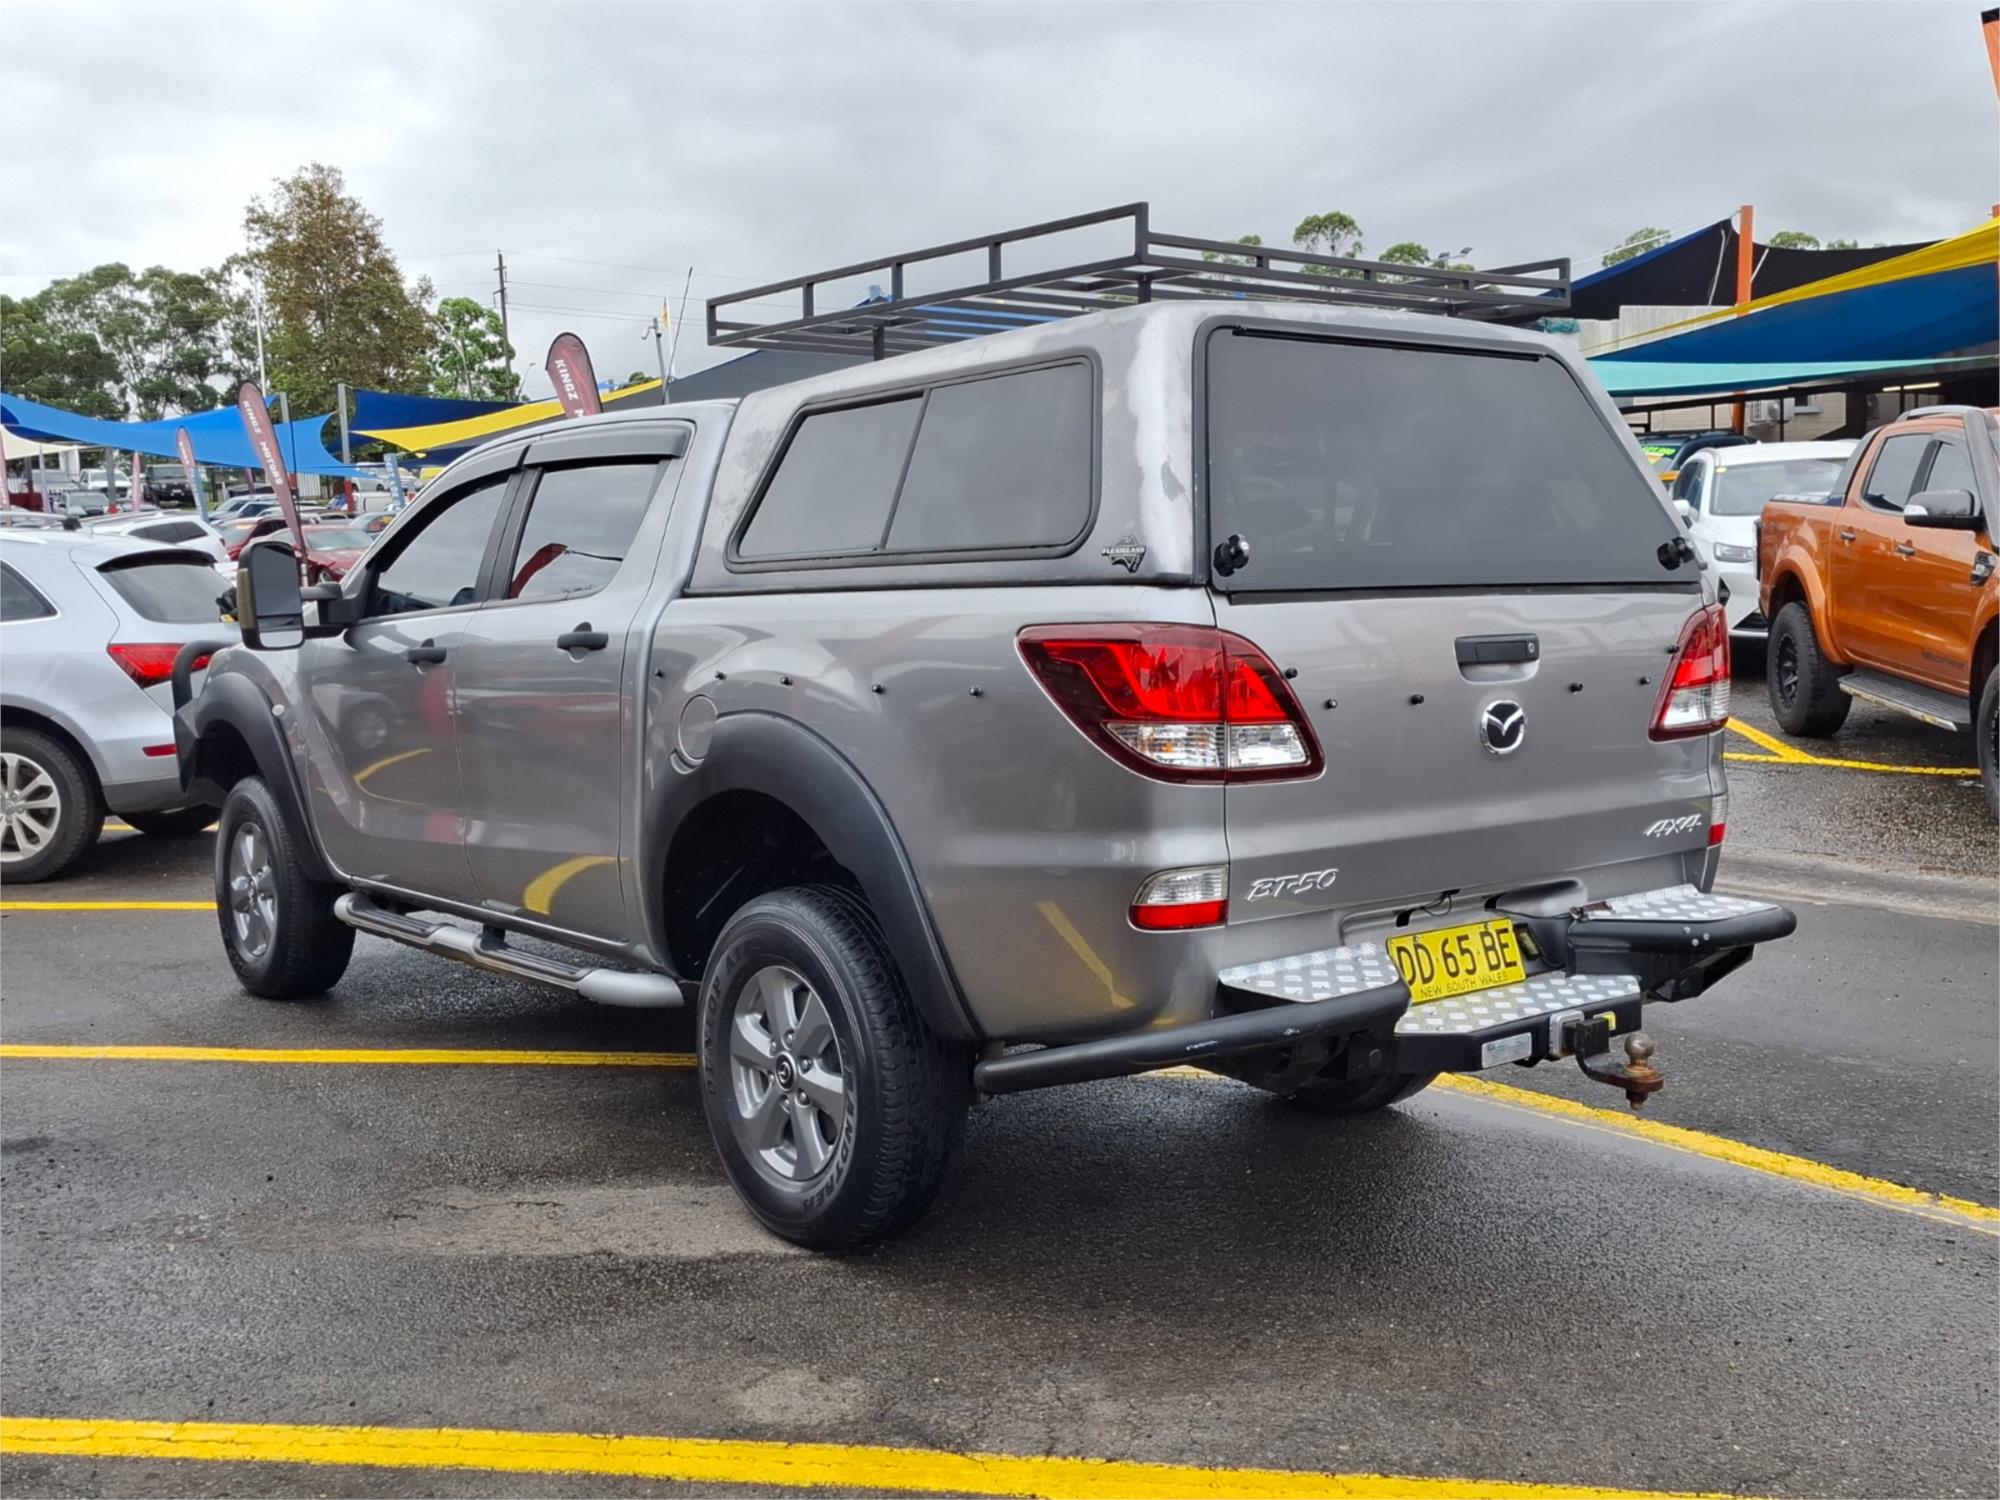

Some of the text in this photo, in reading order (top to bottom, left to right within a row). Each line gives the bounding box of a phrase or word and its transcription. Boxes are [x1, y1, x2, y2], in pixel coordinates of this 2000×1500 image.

[555, 359, 579, 401] KINGZ
[242, 400, 284, 485] KINGZ MOTORS
[1246, 867, 1339, 901] BT-50
[1441, 934, 1477, 978] 65
[1480, 928, 1518, 971] BE
[1420, 972, 1509, 998] NEW SOUTH WALES
